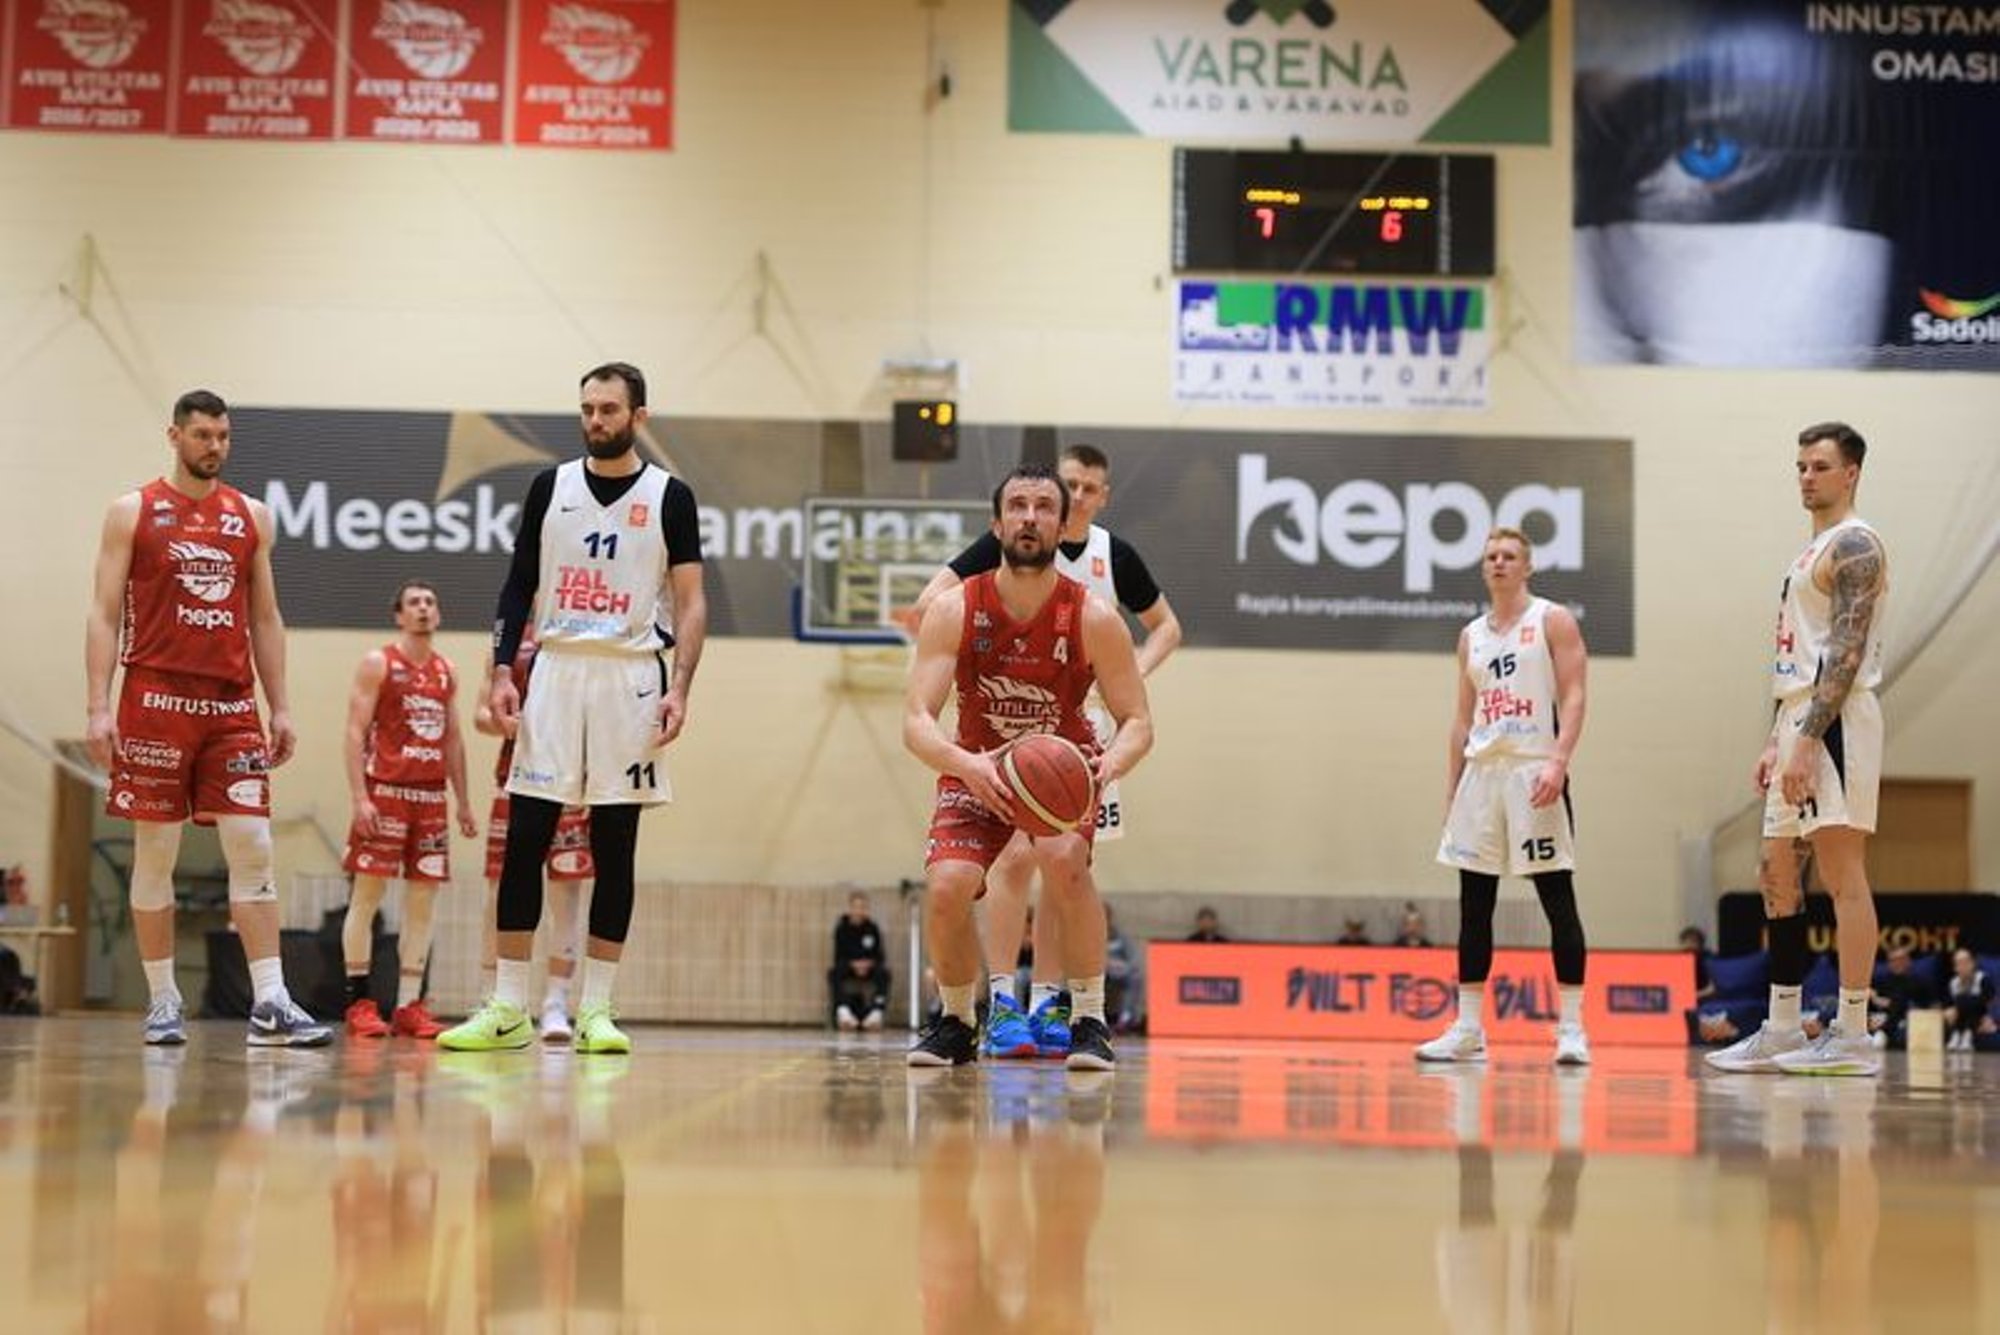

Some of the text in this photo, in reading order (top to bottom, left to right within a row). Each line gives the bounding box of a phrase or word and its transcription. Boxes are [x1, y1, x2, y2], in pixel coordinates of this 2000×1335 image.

[1151, 36, 1409, 91] VARENA
[1255, 208, 1275, 238] 7
[1381, 211, 1403, 242] 6
[1276, 285, 1472, 357] RMW
[220, 513, 246, 538] 22
[1237, 453, 1583, 593] hepa
[583, 531, 618, 560] 11
[559, 565, 608, 590] TAL
[556, 588, 631, 615] TECH
[177, 604, 234, 630] hepa
[1053, 636, 1068, 665] 4
[1489, 653, 1517, 680] 15
[626, 761, 657, 790] 11
[1521, 836, 1556, 861] 15
